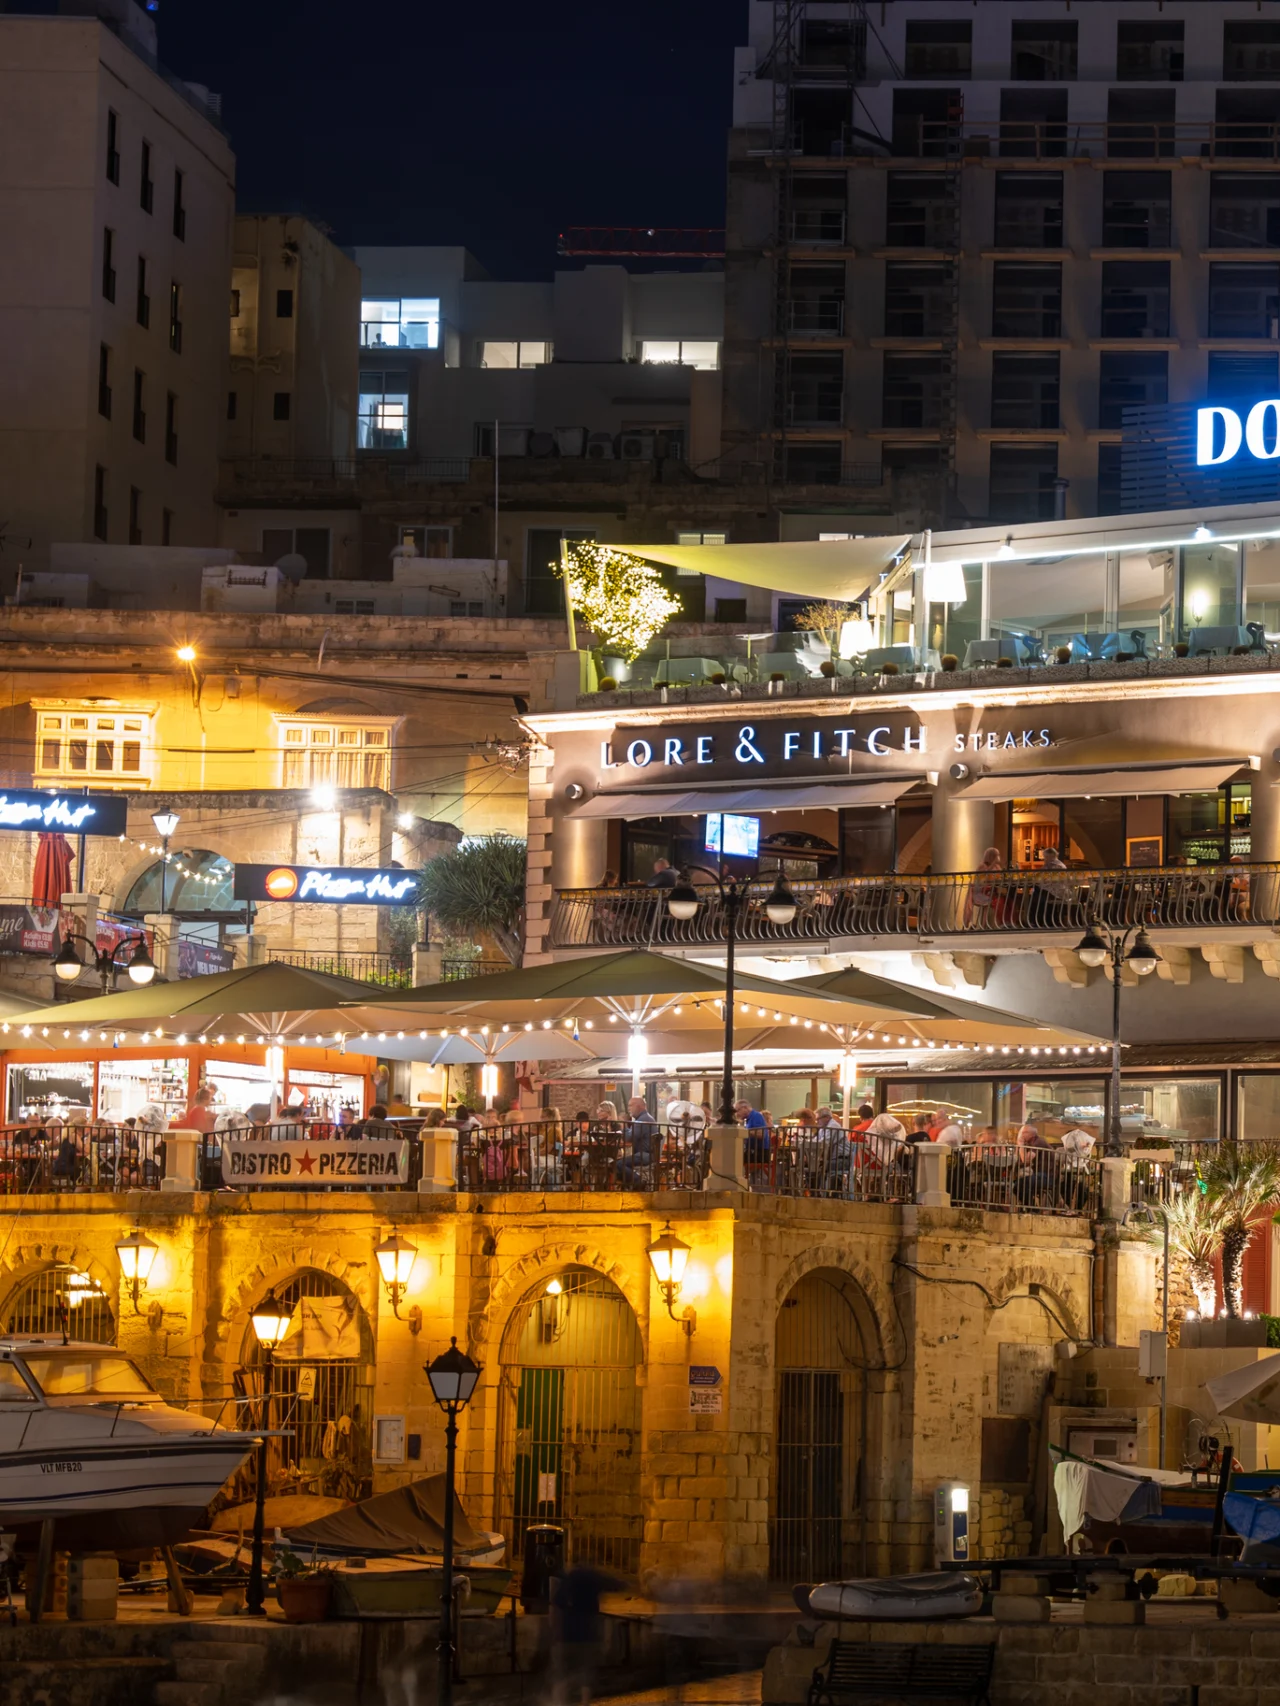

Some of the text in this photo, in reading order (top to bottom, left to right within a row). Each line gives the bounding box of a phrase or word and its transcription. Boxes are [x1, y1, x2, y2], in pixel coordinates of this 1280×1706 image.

[600, 725, 927, 769] LORE & FITCH
[954, 729, 1051, 753] STEAKS
[230, 1151, 399, 1176] BISTRO PIZZERIA
[41, 1463, 54, 1473] VLT
